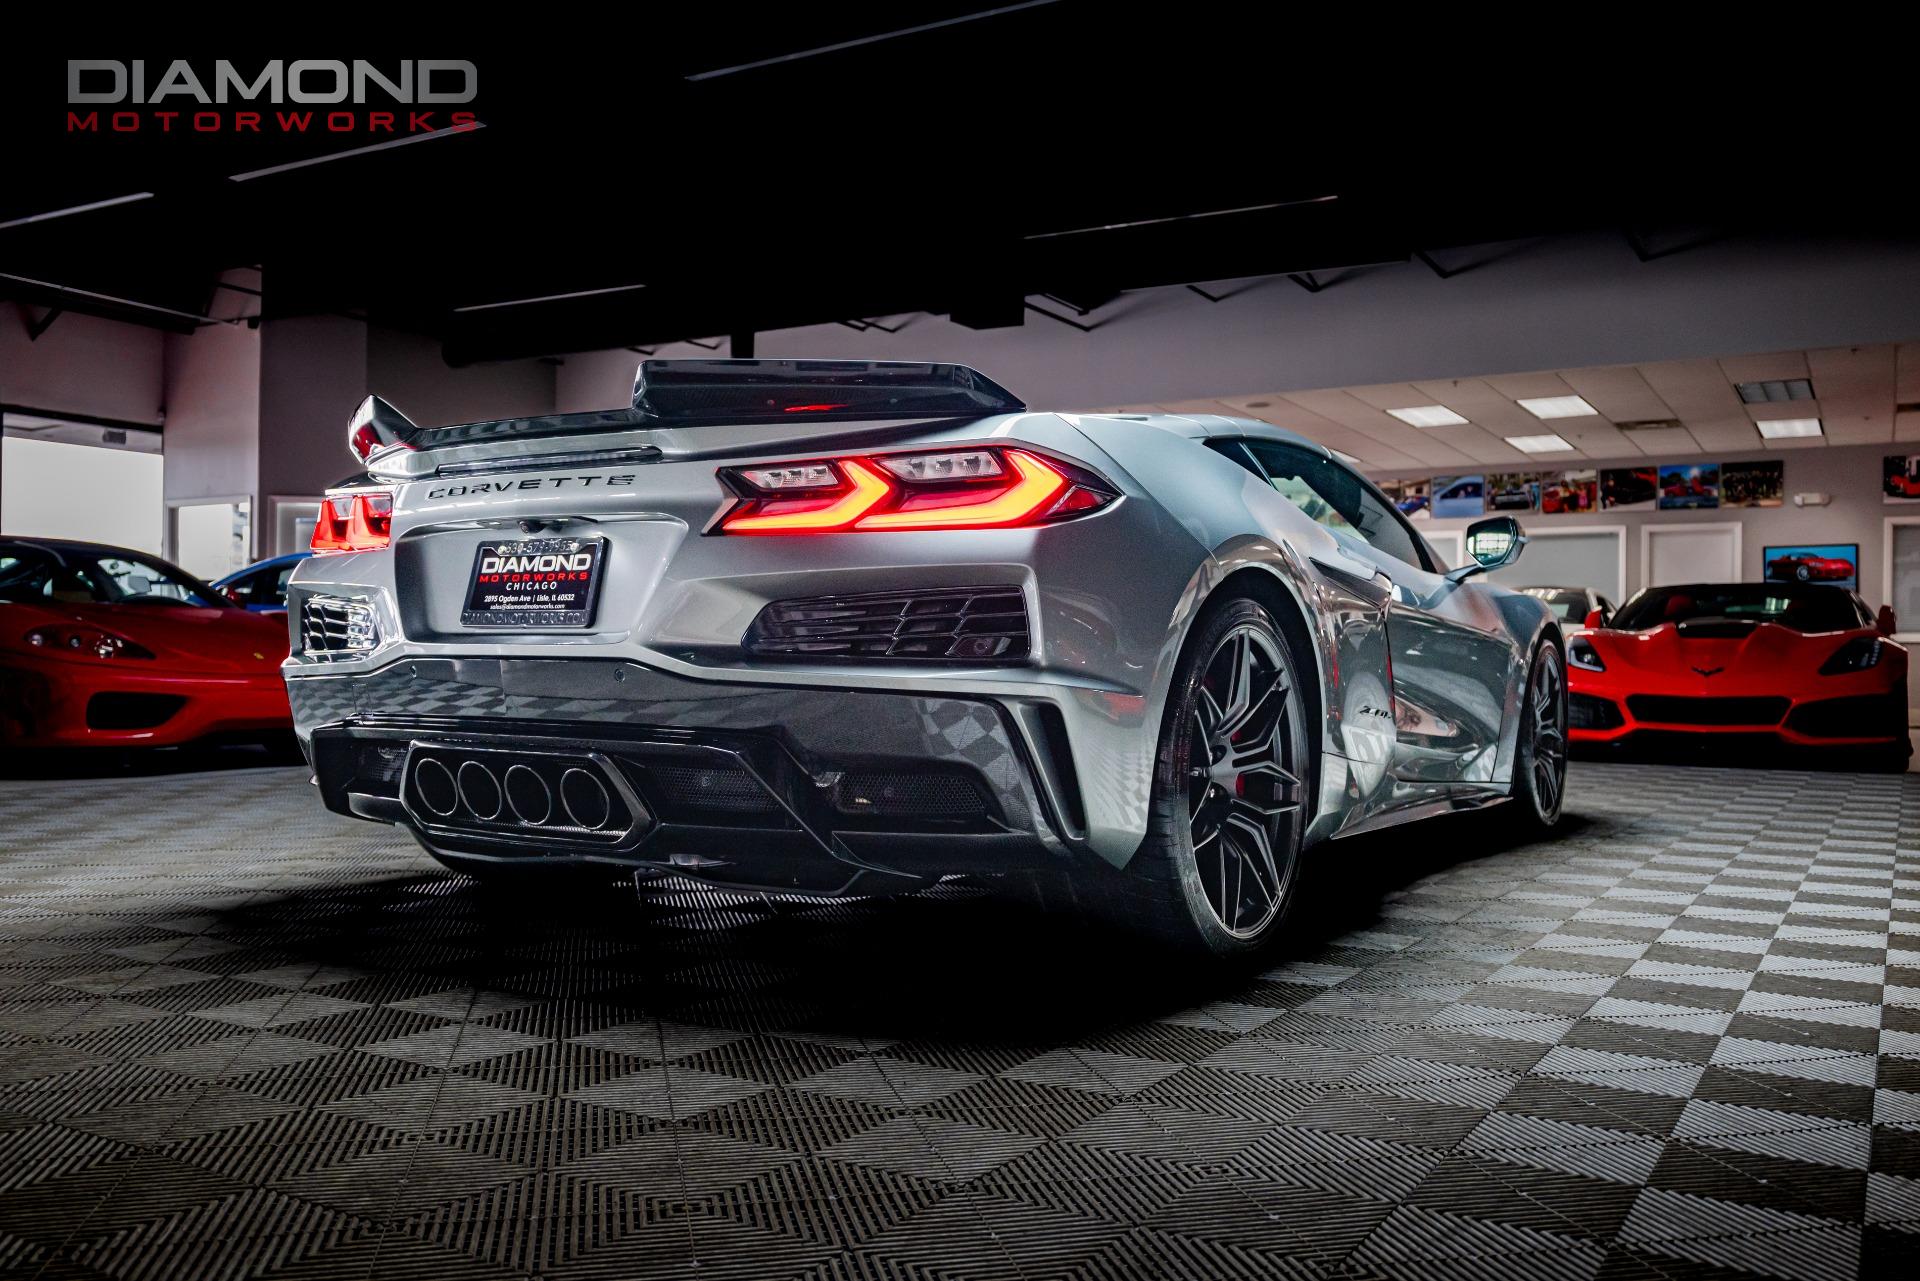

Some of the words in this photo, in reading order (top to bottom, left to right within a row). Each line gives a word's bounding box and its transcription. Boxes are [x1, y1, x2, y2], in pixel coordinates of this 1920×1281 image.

[428, 474, 636, 499] CORVETTE
[481, 553, 592, 573] DIAMOND
[479, 572, 589, 583] MOTORWORKS
[506, 581, 557, 591] CHICAGO
[498, 595, 518, 603] Ogden
